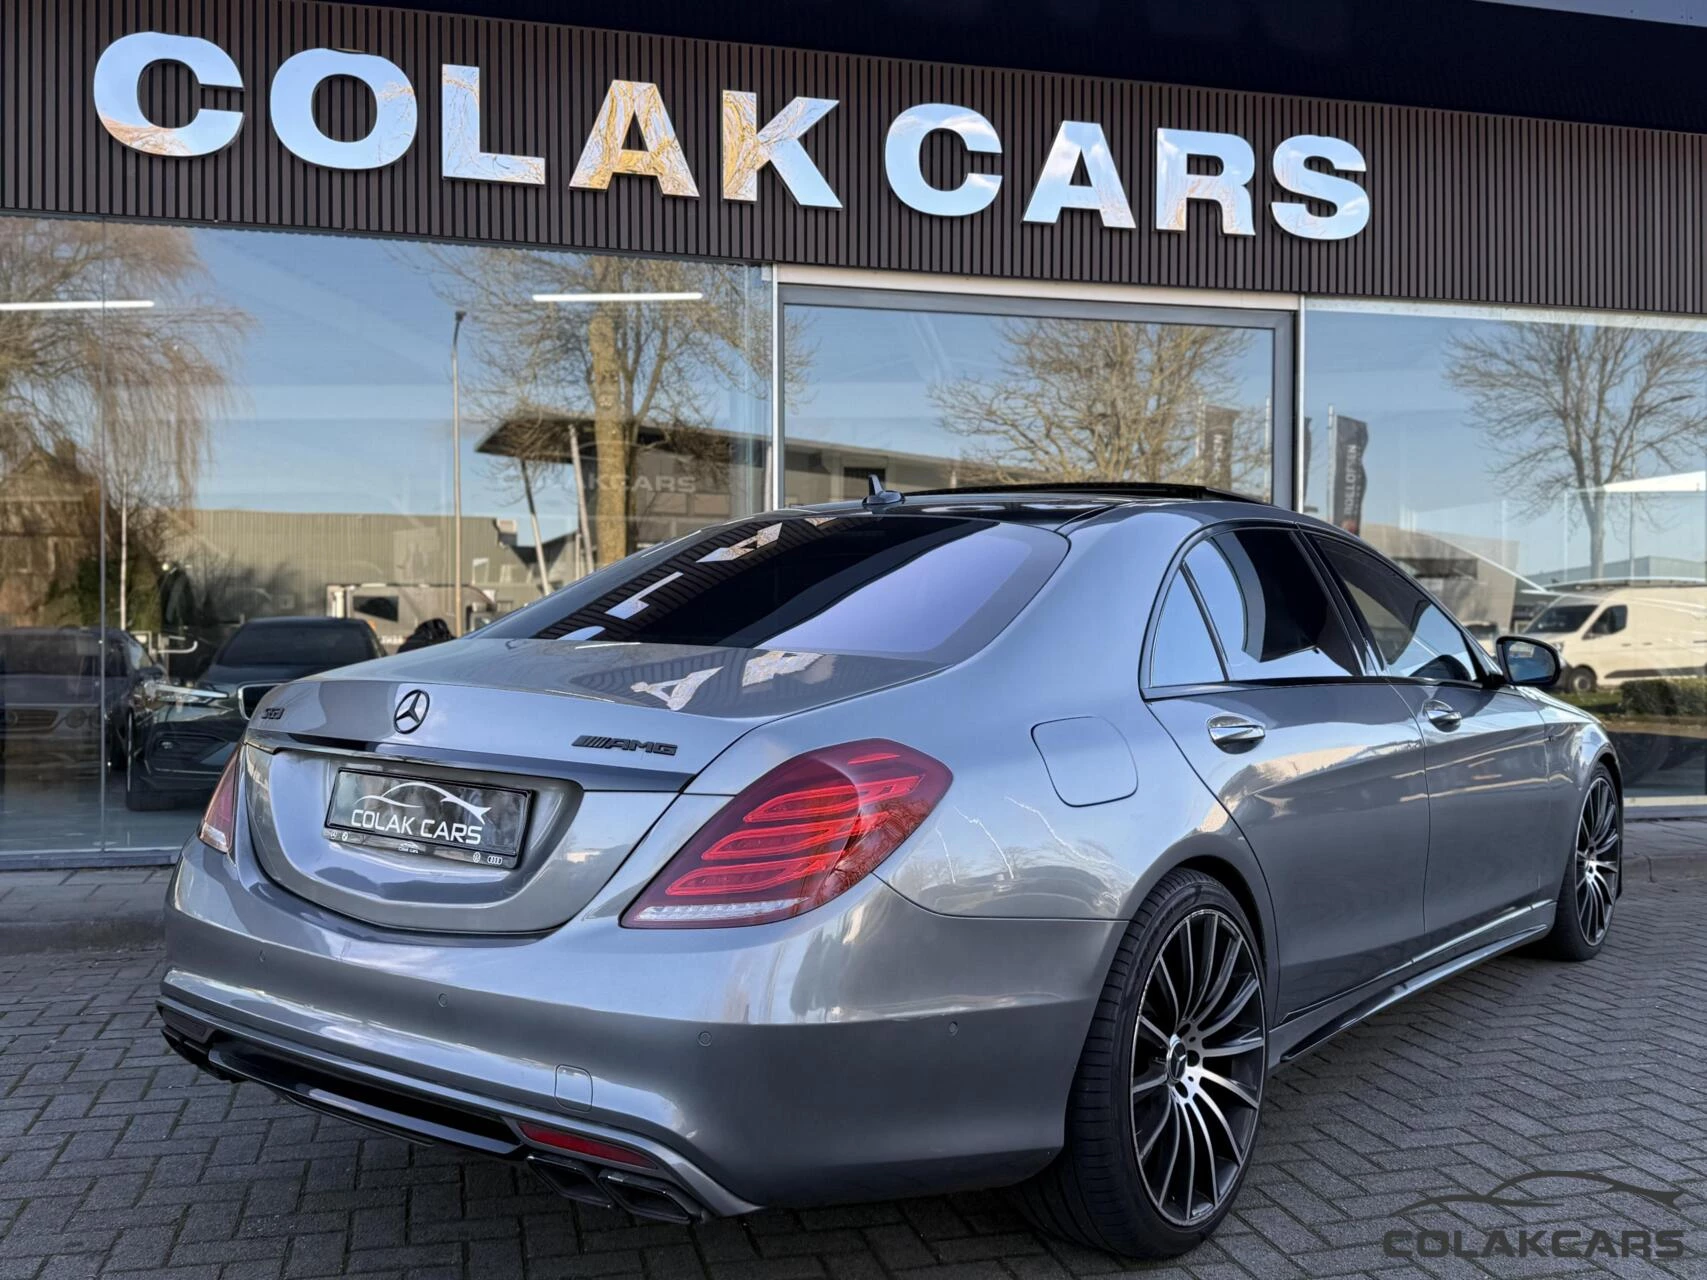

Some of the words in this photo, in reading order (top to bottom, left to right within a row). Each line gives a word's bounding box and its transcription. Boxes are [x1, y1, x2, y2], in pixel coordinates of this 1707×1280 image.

[93, 31, 843, 209] COLAK
[885, 102, 1371, 242] CARS
[604, 738, 678, 756] AMG
[351, 809, 415, 836] COLAK
[420, 819, 483, 845] CARS
